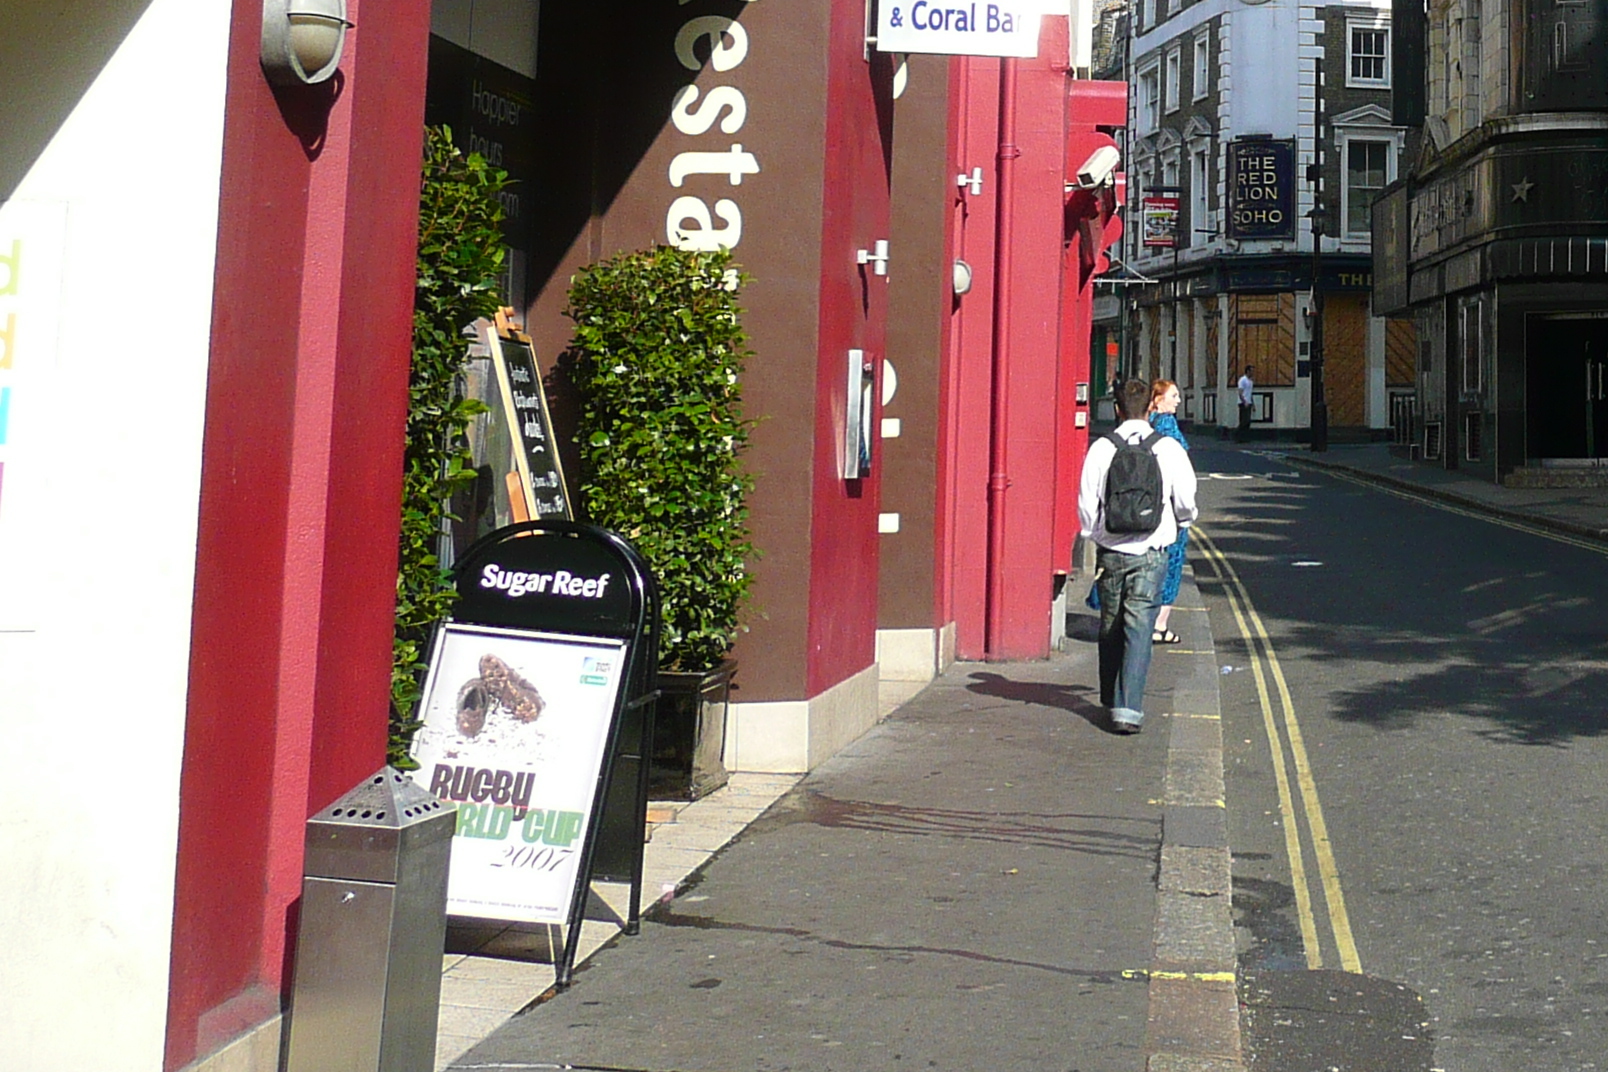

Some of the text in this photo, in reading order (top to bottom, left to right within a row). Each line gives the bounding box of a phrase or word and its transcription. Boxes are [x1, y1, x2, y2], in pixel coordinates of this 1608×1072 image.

[890, 0, 1022, 33] & Coral Bar
[471, 78, 521, 127] Happier
[1237, 156, 1277, 171] THE
[1237, 171, 1277, 186] RED
[1236, 186, 1279, 201] LION
[1232, 209, 1283, 225] SOHO
[480, 563, 611, 599] Sugar Reef
[430, 763, 536, 819] RUGBY
[449, 801, 586, 848] RLD CUP
[490, 844, 574, 874] 2007
